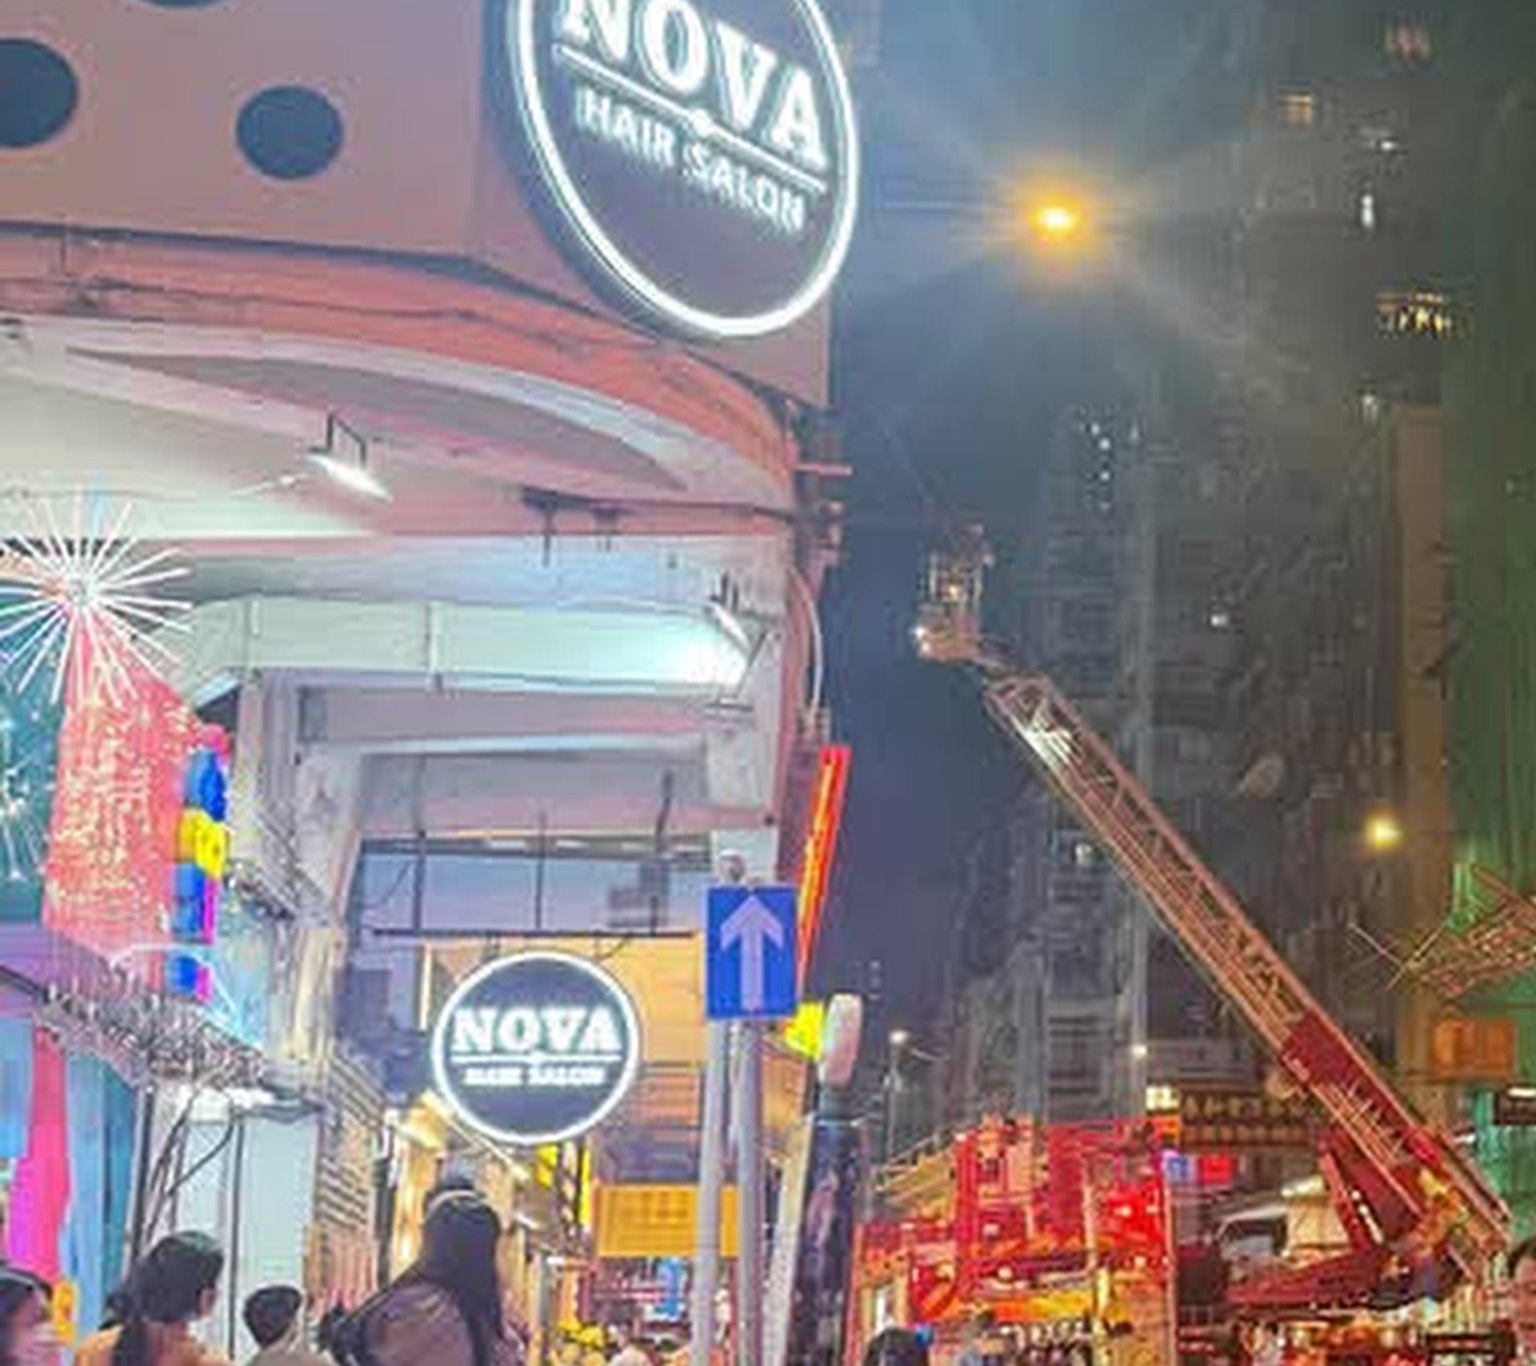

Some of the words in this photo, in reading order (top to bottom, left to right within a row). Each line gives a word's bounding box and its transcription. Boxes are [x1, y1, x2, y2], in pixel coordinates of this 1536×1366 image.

[577, 84, 675, 167] HAIR
[683, 142, 804, 231] SALON
[453, 1005, 623, 1053] NOVA
